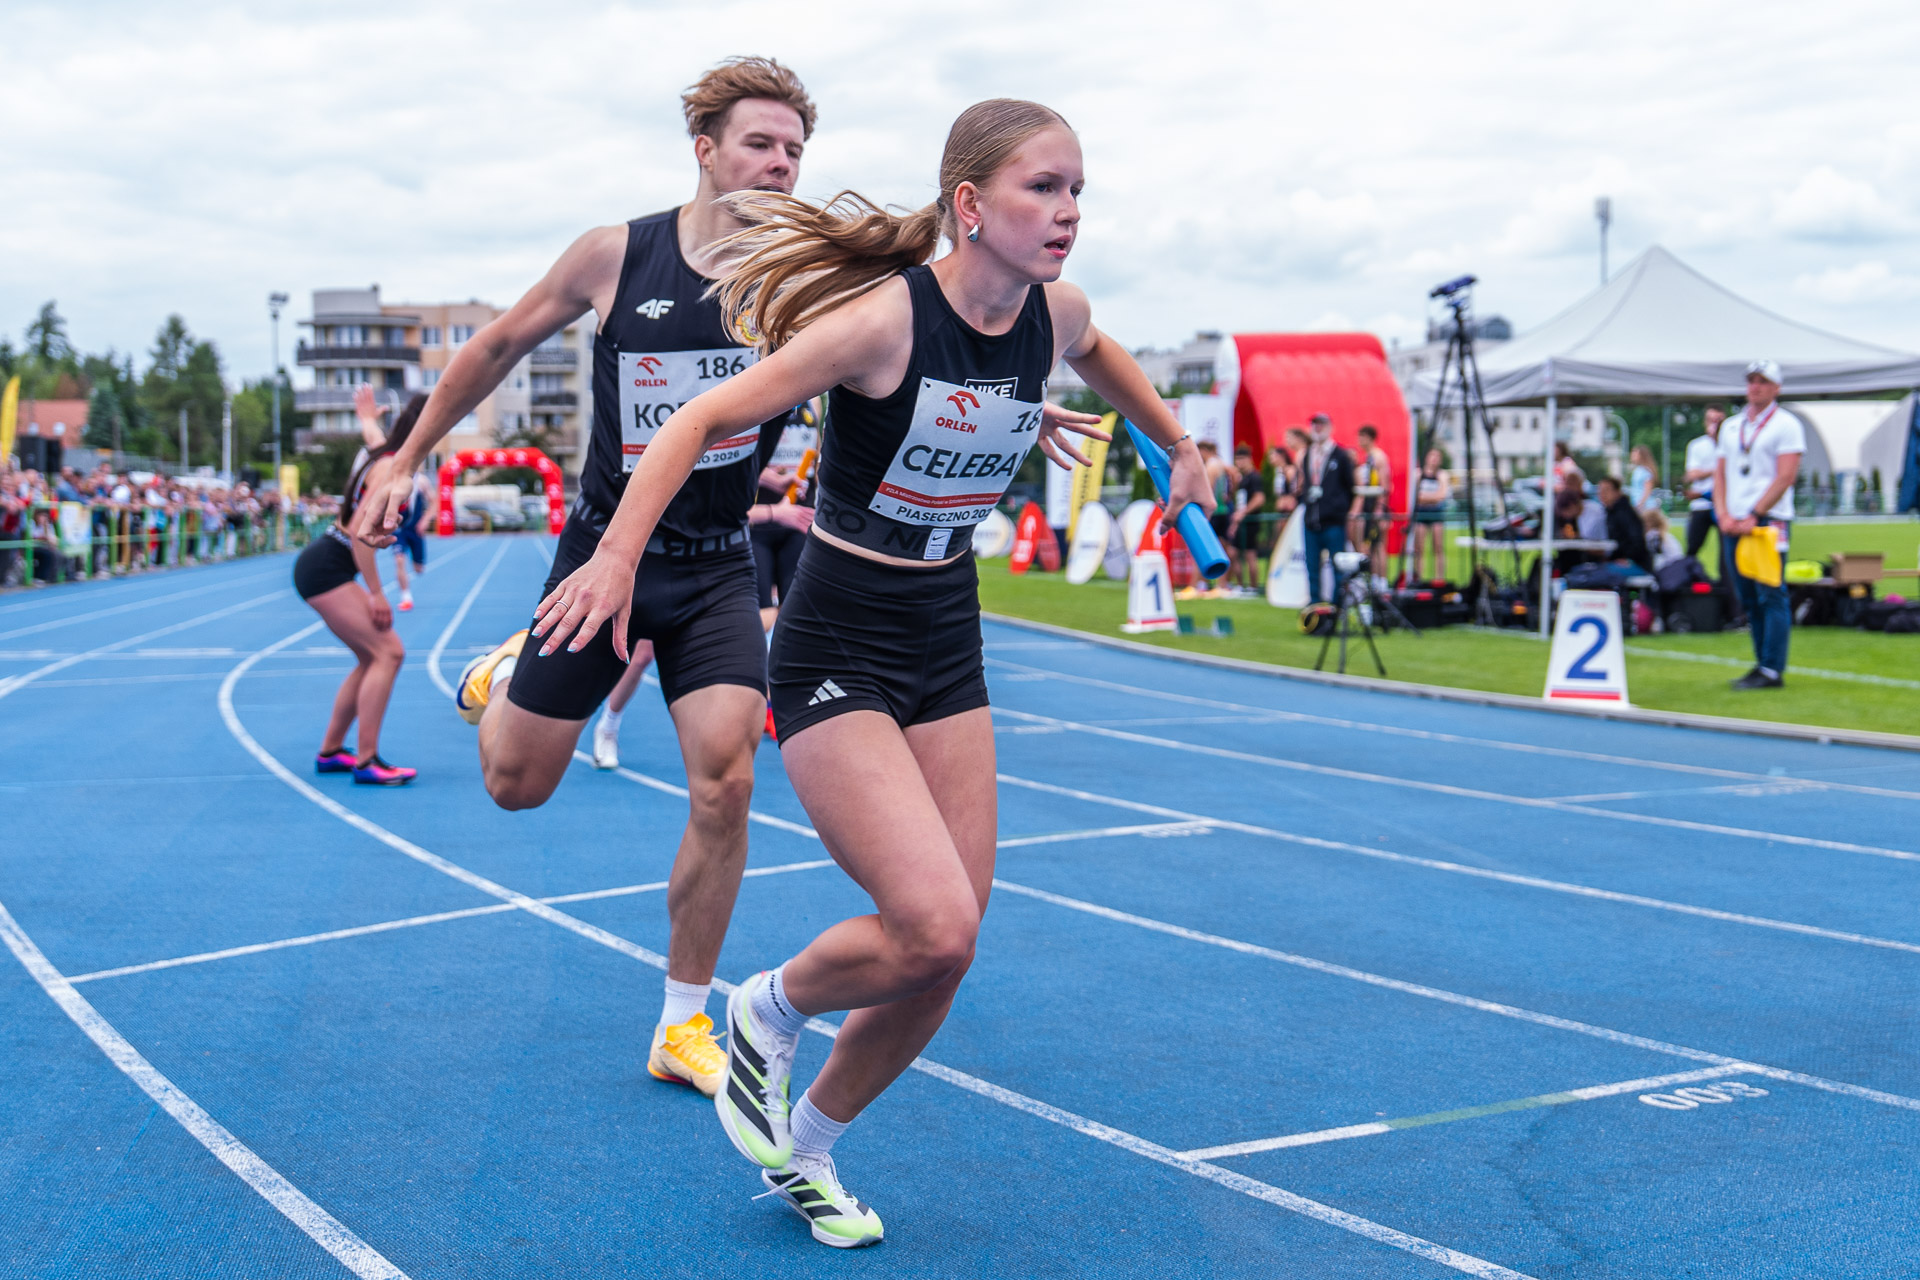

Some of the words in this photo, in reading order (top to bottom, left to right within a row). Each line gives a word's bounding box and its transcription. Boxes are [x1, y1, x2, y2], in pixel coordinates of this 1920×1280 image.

[636, 298, 675, 320] 4F
[697, 355, 746, 380] 186
[634, 378, 668, 387] ORLEN
[634, 402, 686, 429] KO
[935, 416, 978, 434] ORLEN
[713, 450, 740, 463] 2026
[902, 445, 1027, 479] CELEBA
[896, 505, 970, 522] PIASECZNO
[1146, 572, 1162, 612] 1
[1566, 615, 1609, 680] 2
